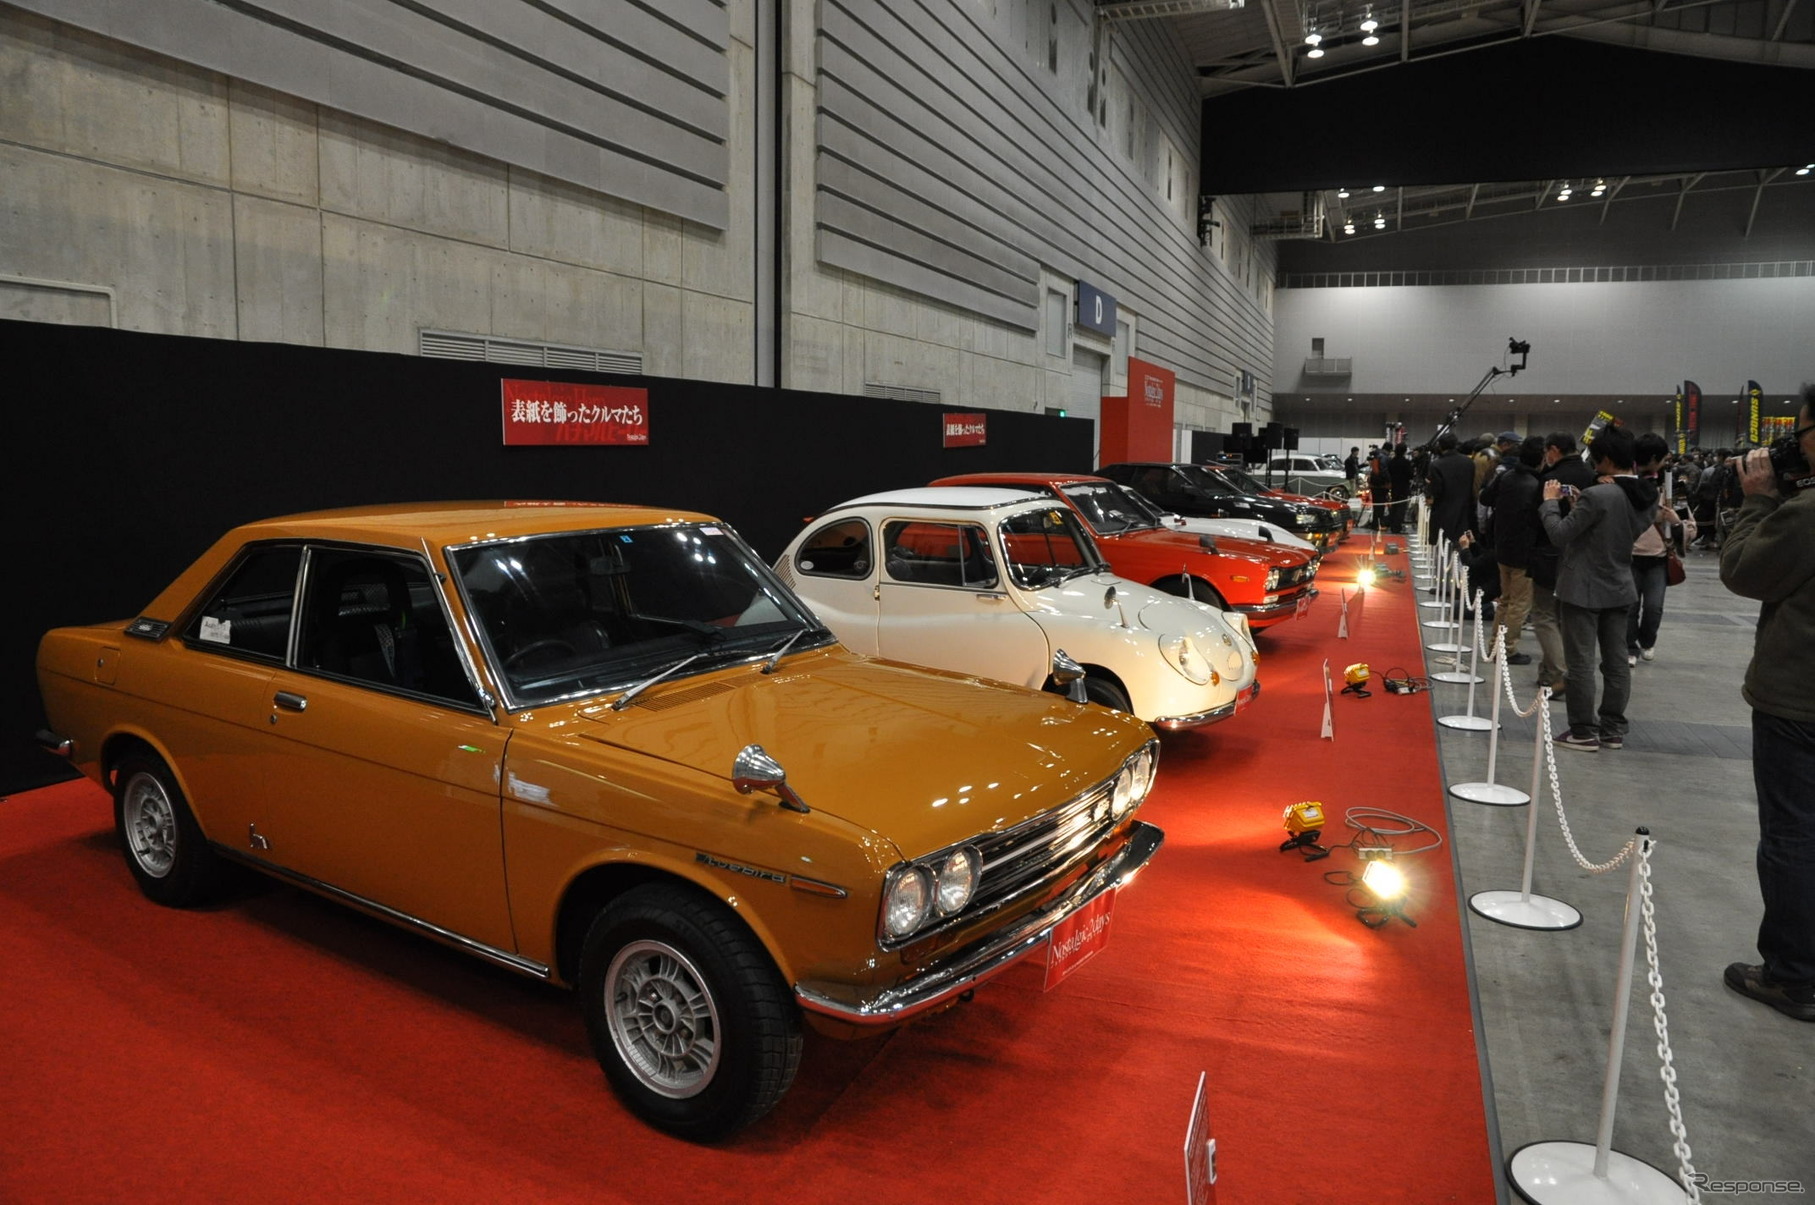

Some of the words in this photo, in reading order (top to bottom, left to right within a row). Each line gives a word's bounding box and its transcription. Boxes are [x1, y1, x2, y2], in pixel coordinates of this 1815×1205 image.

[1094, 295, 1103, 325] D
[510, 398, 643, 426] 表紙を飾ったクルマたち
[1750, 396, 1760, 443] SUNOCO
